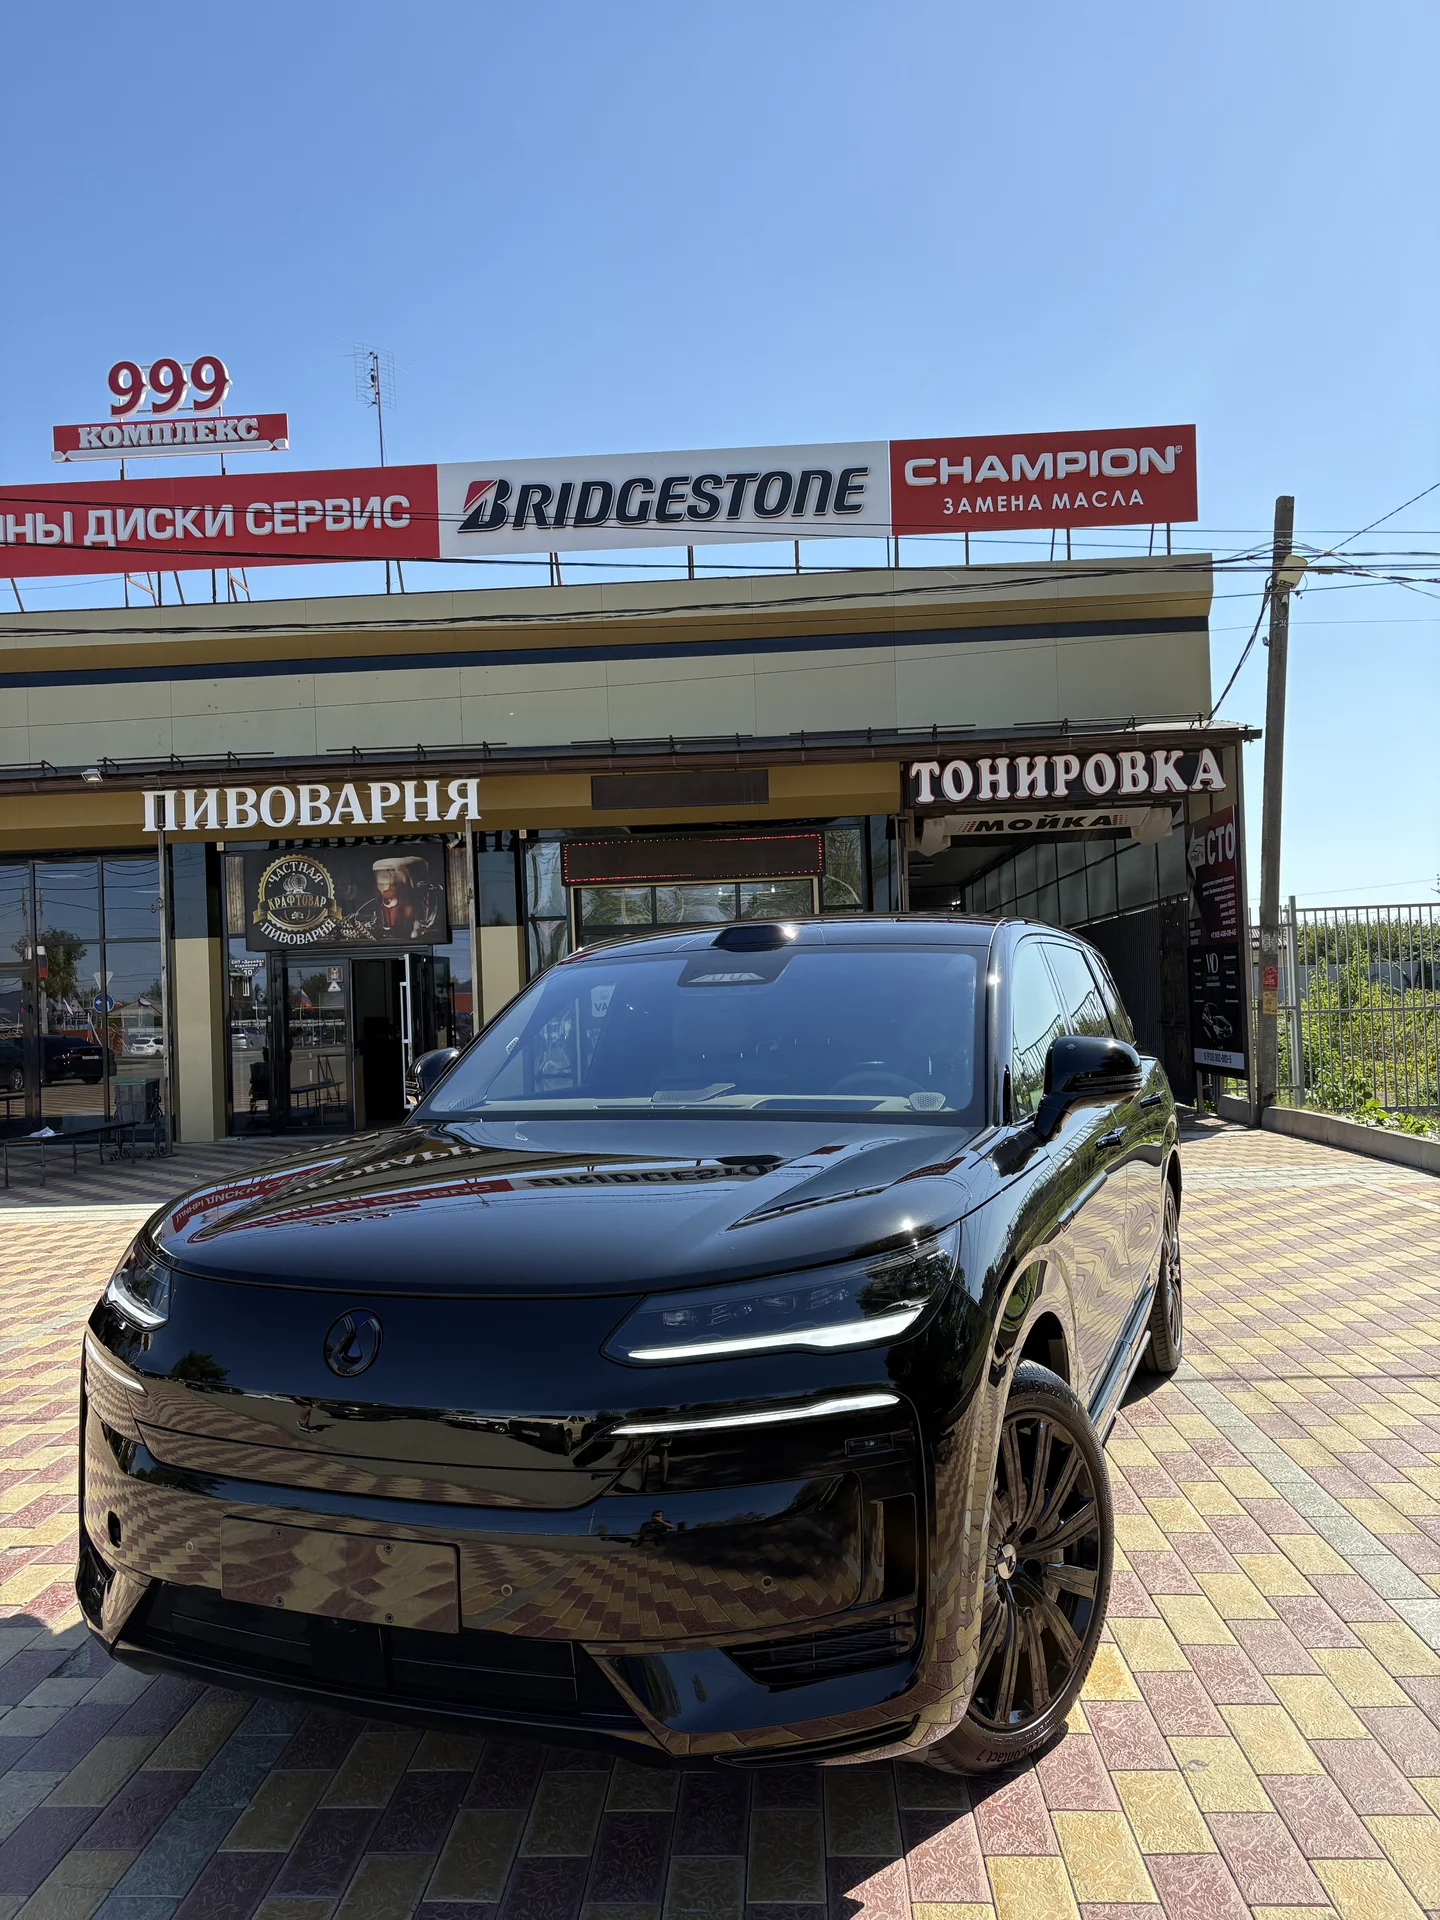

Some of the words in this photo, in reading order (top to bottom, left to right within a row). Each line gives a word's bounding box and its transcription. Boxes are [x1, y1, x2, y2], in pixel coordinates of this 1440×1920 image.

[107, 355, 232, 418] 999
[78, 418, 259, 450] КОМПЛЕКС
[457, 467, 870, 533] BRIDGESTONE
[942, 494, 1043, 515] ЗАМЕНА
[1051, 489, 1144, 510] МАСЛА
[83, 505, 235, 547] ДИСКИ
[245, 494, 411, 536] СЕРВИС
[910, 748, 1227, 804] ТОНИРОВКА
[142, 778, 481, 832] ПИВОВАРНЯ
[972, 813, 1114, 833] МОЙКА
[1206, 823, 1236, 865] СТО
[268, 861, 324, 884] ЧАСТНАЯ
[267, 894, 327, 910] КРАФТОВАР
[260, 919, 336, 945] ПИВОВАРНЯ
